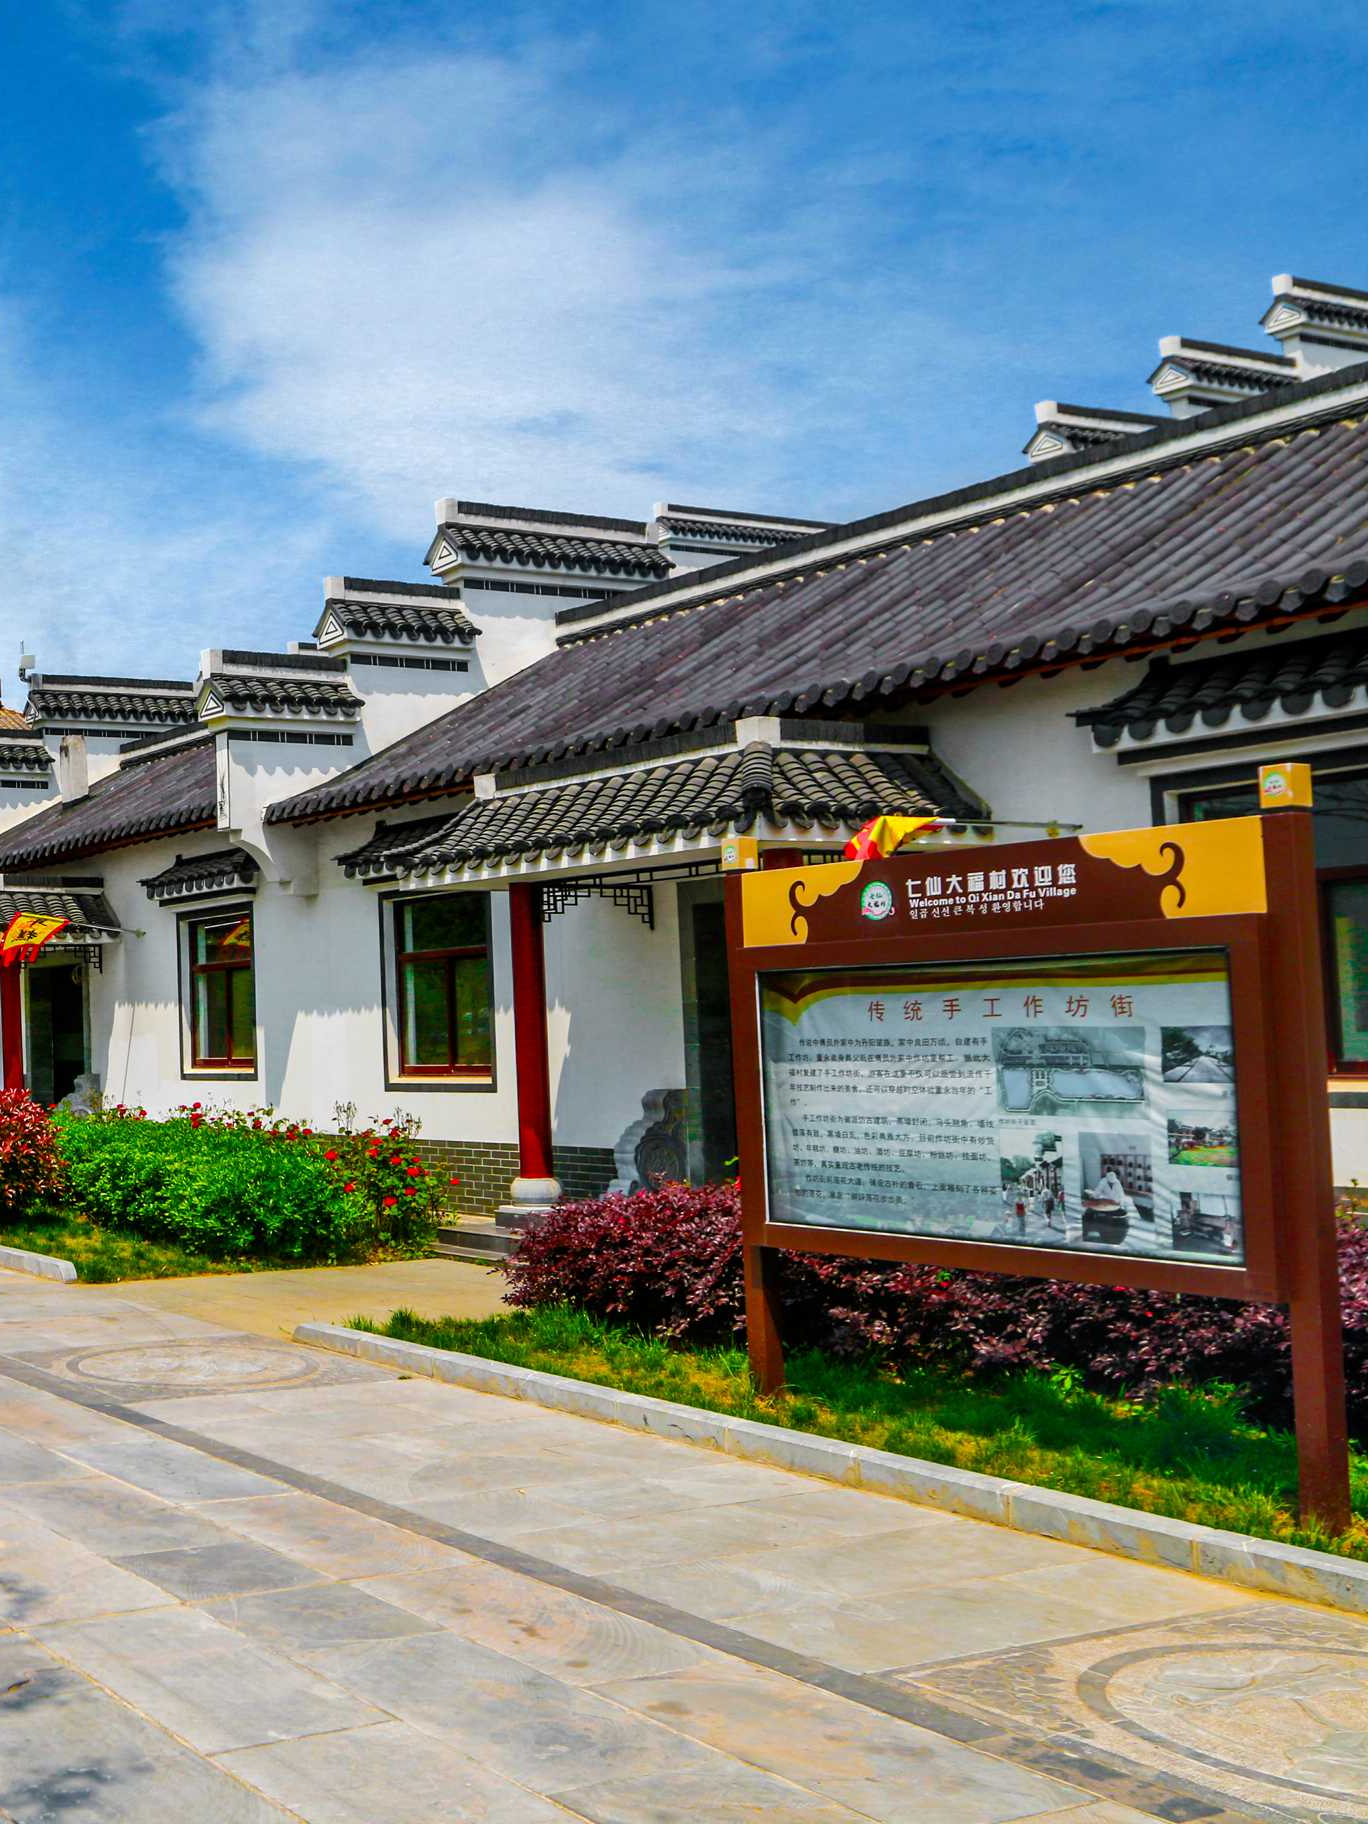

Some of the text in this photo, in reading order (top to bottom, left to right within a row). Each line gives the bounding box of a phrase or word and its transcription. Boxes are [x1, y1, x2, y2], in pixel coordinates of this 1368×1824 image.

[905, 863, 1077, 898] 七仙大福村欢迎您
[909, 886, 1077, 908] Welcome to Qi Xian Da Fu Village
[991, 898, 1045, 914] 환영합니다
[868, 995, 1133, 1022] 传统手工作坊街
